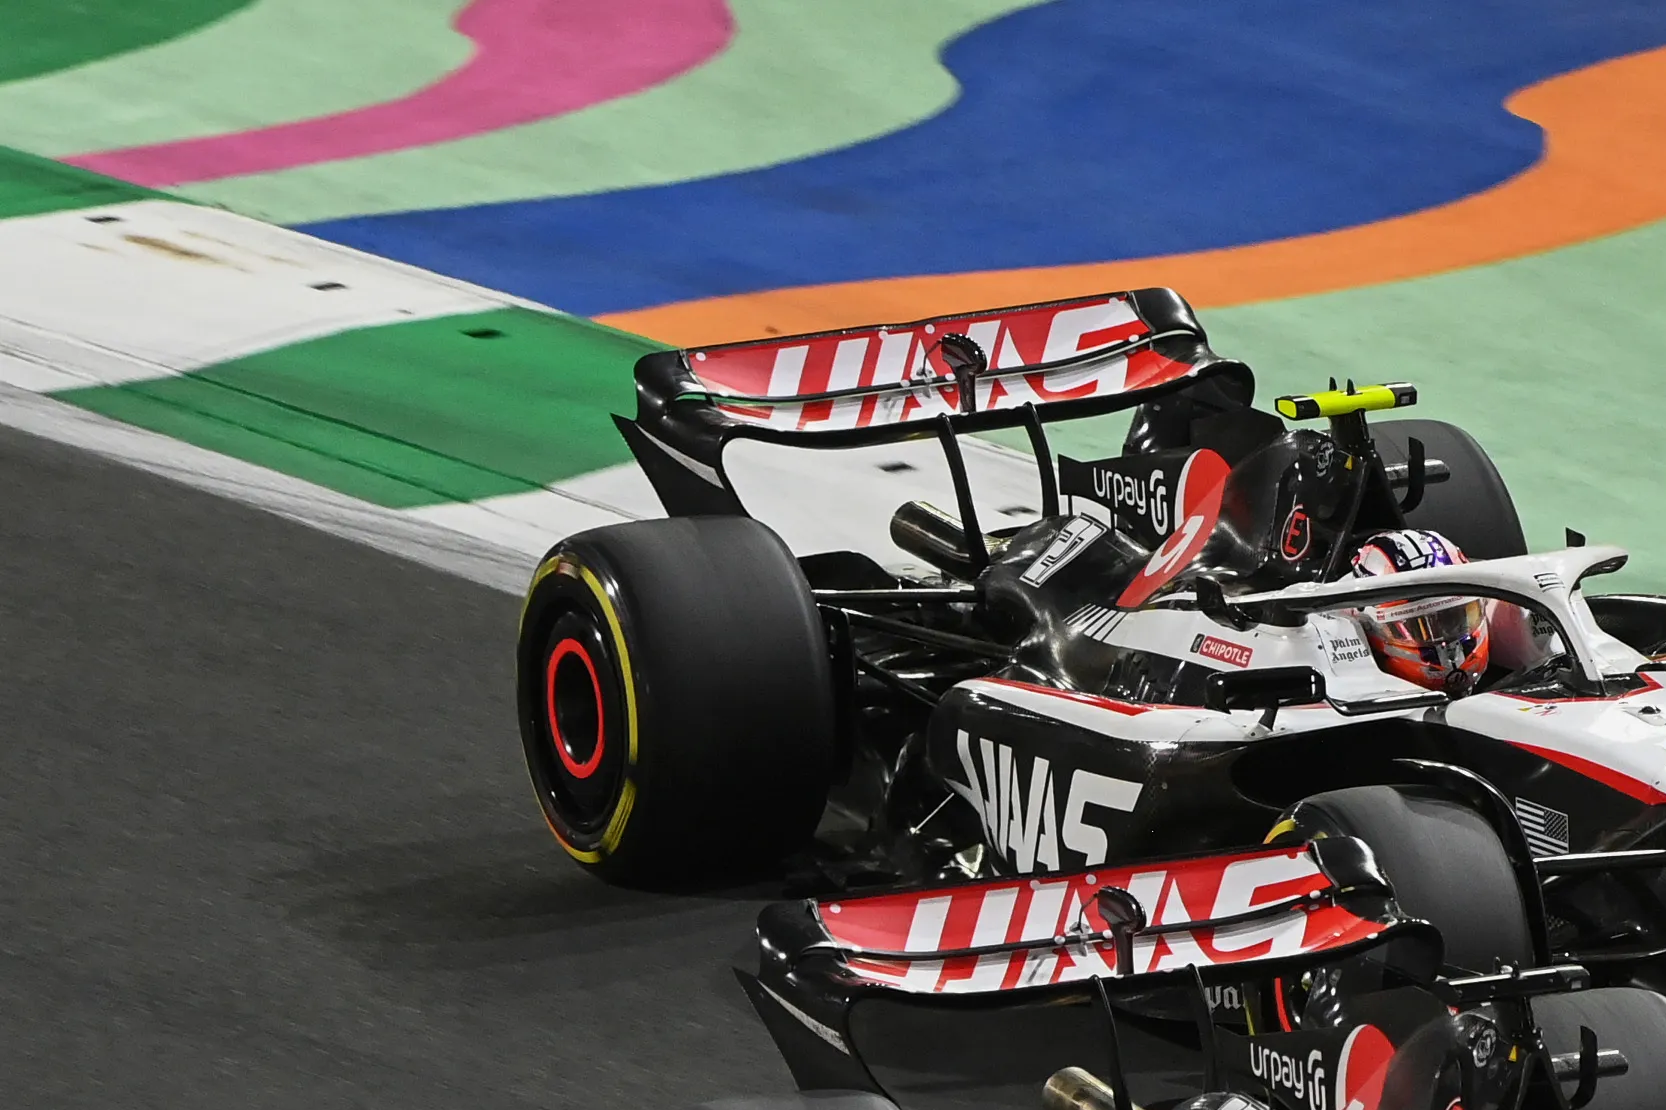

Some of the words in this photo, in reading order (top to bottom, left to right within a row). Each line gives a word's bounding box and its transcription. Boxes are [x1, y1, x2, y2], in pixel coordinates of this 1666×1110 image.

[720, 296, 1139, 430] HAAS
[1093, 467, 1147, 515] urpay
[1202, 640, 1250, 664] CHIPOTLE
[1329, 638, 1361, 651] Palm
[1331, 648, 1370, 663] Angels
[845, 853, 1320, 992] HAAS
[1250, 1043, 1304, 1099] urpay
